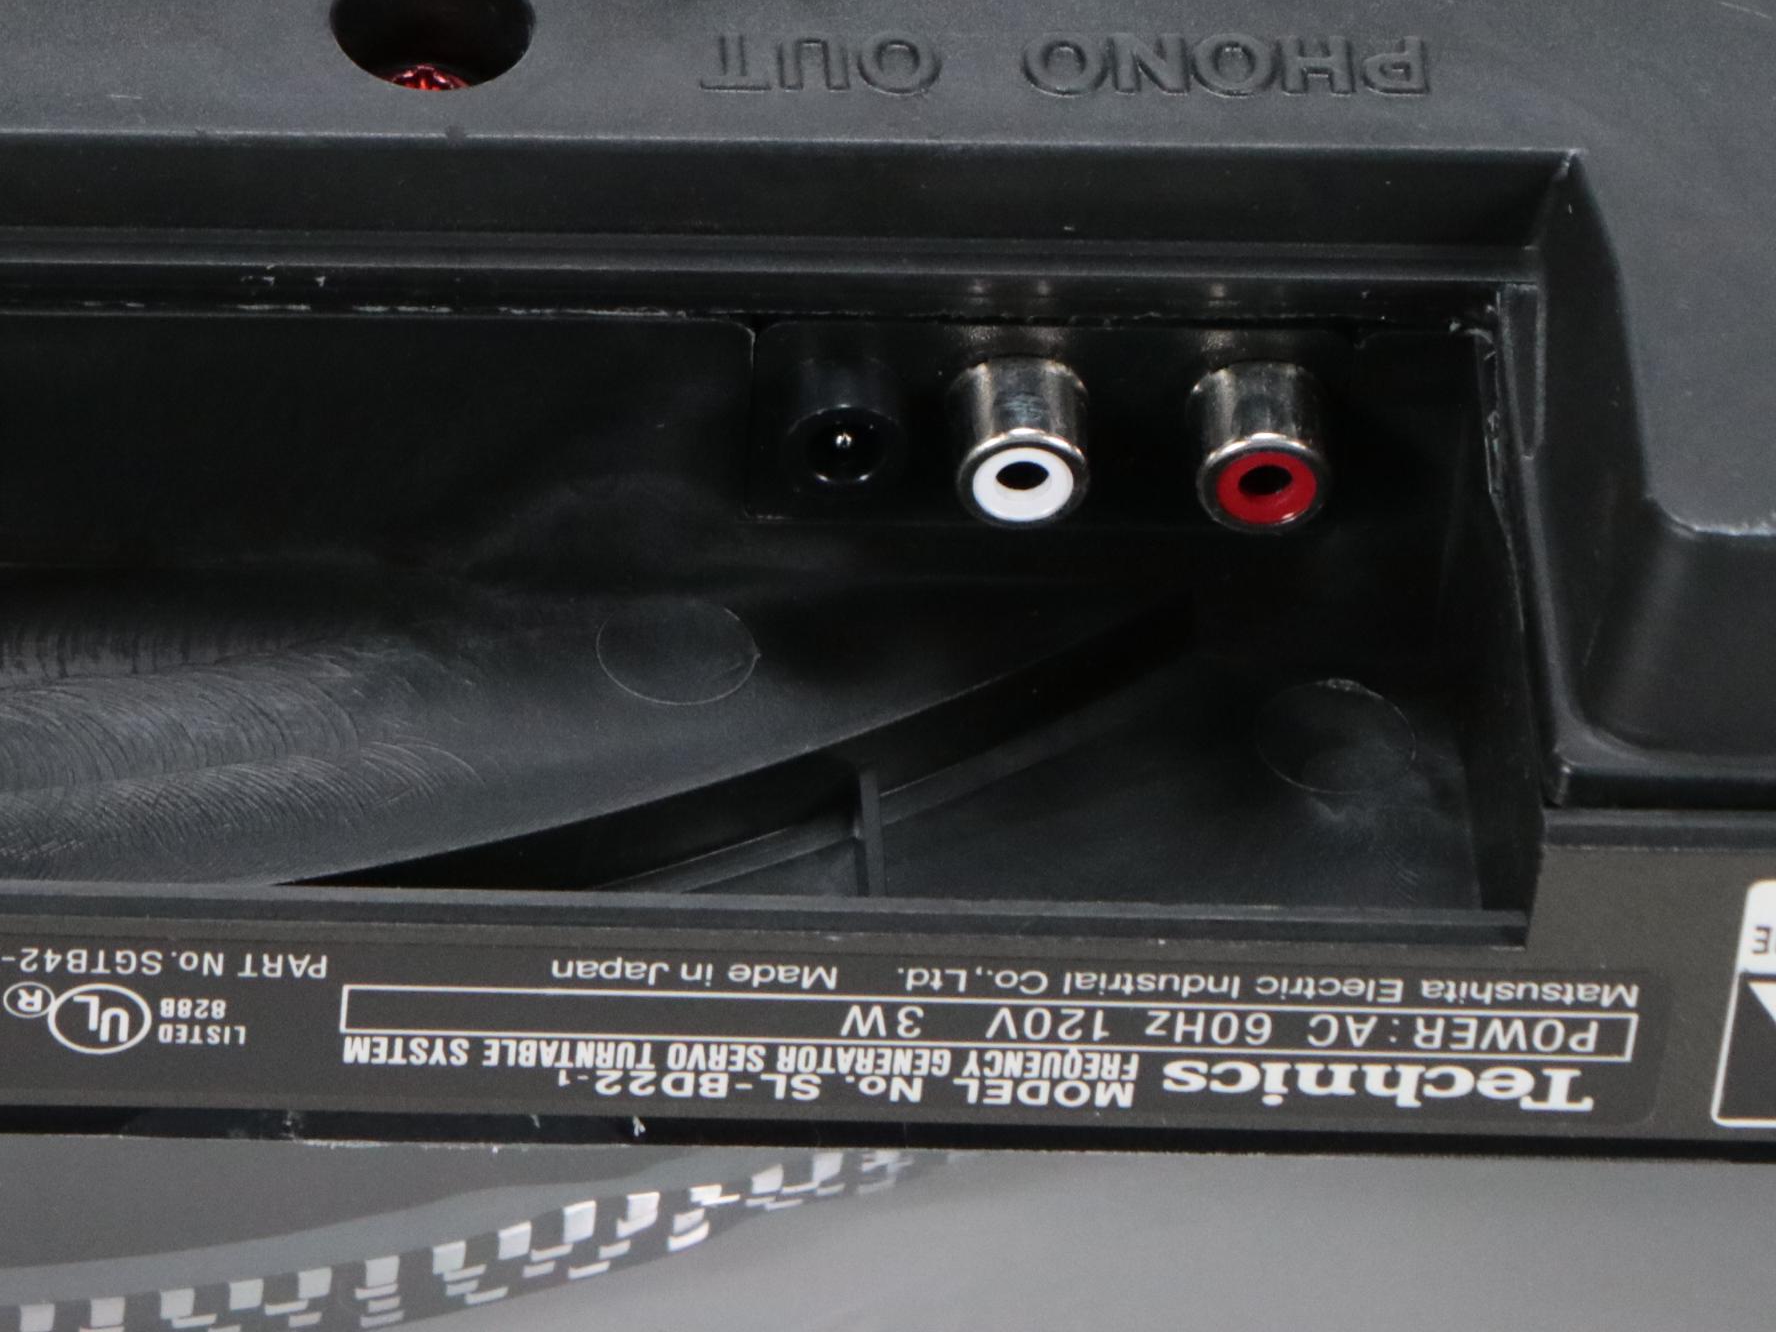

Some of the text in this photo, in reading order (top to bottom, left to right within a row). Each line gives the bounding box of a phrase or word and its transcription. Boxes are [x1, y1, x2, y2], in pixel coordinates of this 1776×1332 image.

[698, 32, 1429, 99] PHONO OUT
[237, 952, 327, 979] PART
[550, 956, 670, 987] Japan
[680, 962, 714, 988] in
[727, 963, 839, 991] Made
[1062, 971, 1241, 1000] Industrial
[1254, 974, 1405, 1005] Electric
[1421, 979, 1640, 1009] Matsushita
[159, 997, 227, 1020] 828B
[157, 1022, 246, 1046] LISTED
[984, 1006, 1110, 1043] 120V
[1143, 1009, 1273, 1047] 60Hz
[341, 1035, 1140, 1081] FREQUENCY GENERATOR SERVO TURNTABLE SYSTEM
[844, 1075, 924, 1103] No.
[952, 1077, 1134, 1108] MODEL
[1162, 1060, 1595, 1113] Technics
